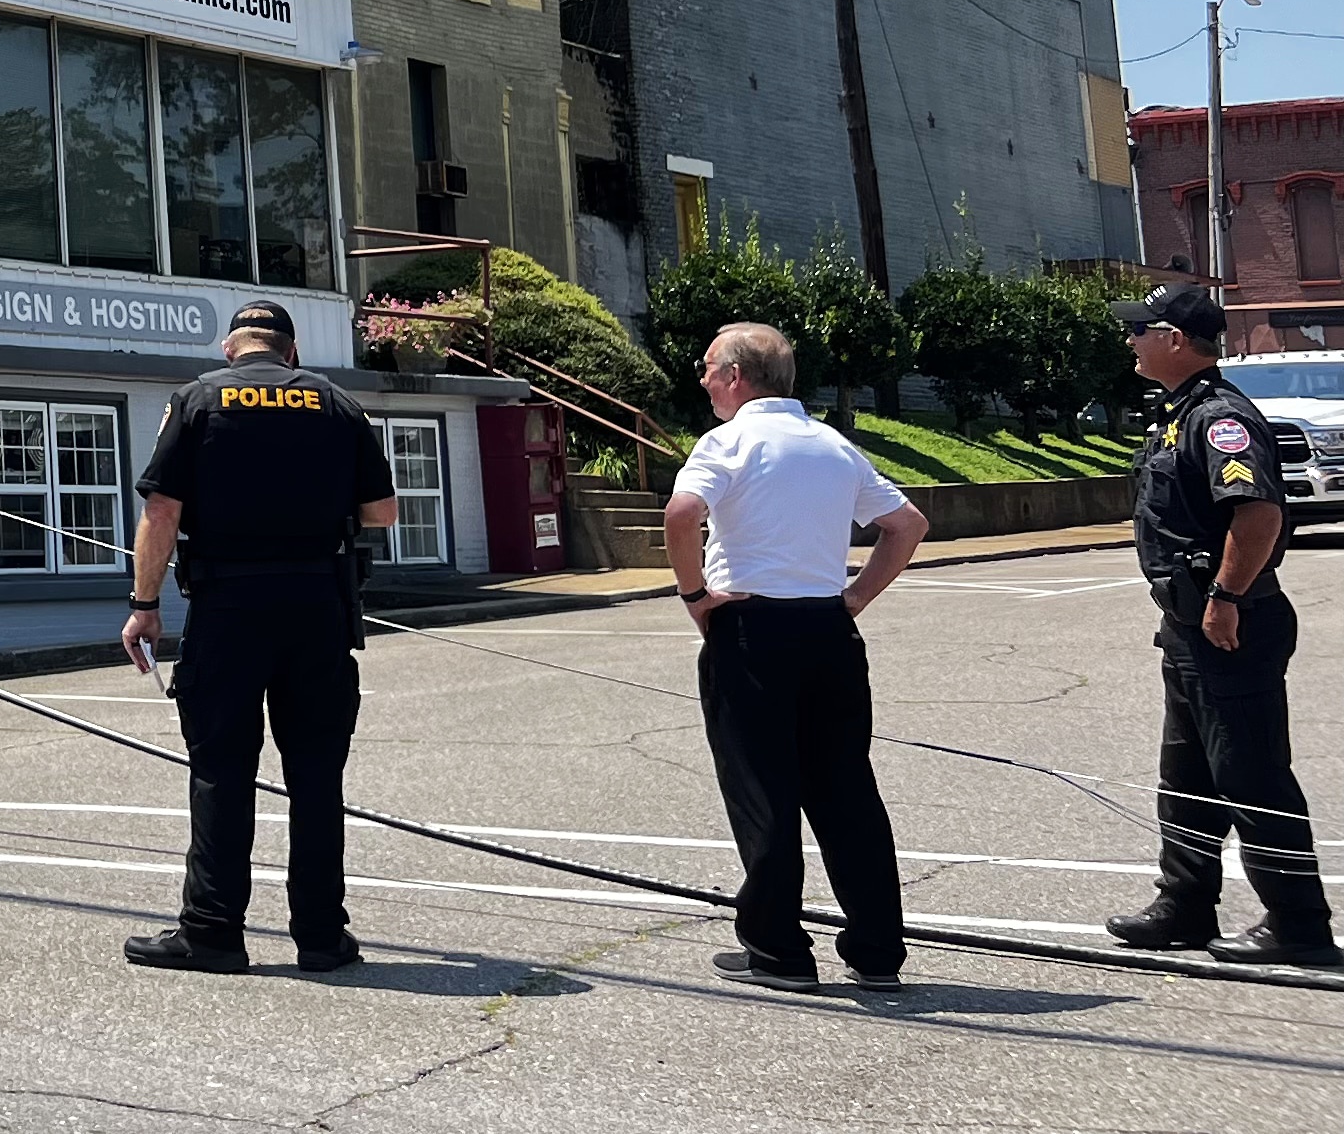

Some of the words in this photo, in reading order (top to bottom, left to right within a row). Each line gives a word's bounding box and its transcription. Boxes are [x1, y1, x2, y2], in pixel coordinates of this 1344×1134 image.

[63, 296, 82, 326] &
[90, 297, 203, 334] HOSTING
[220, 387, 322, 410] POLICE
